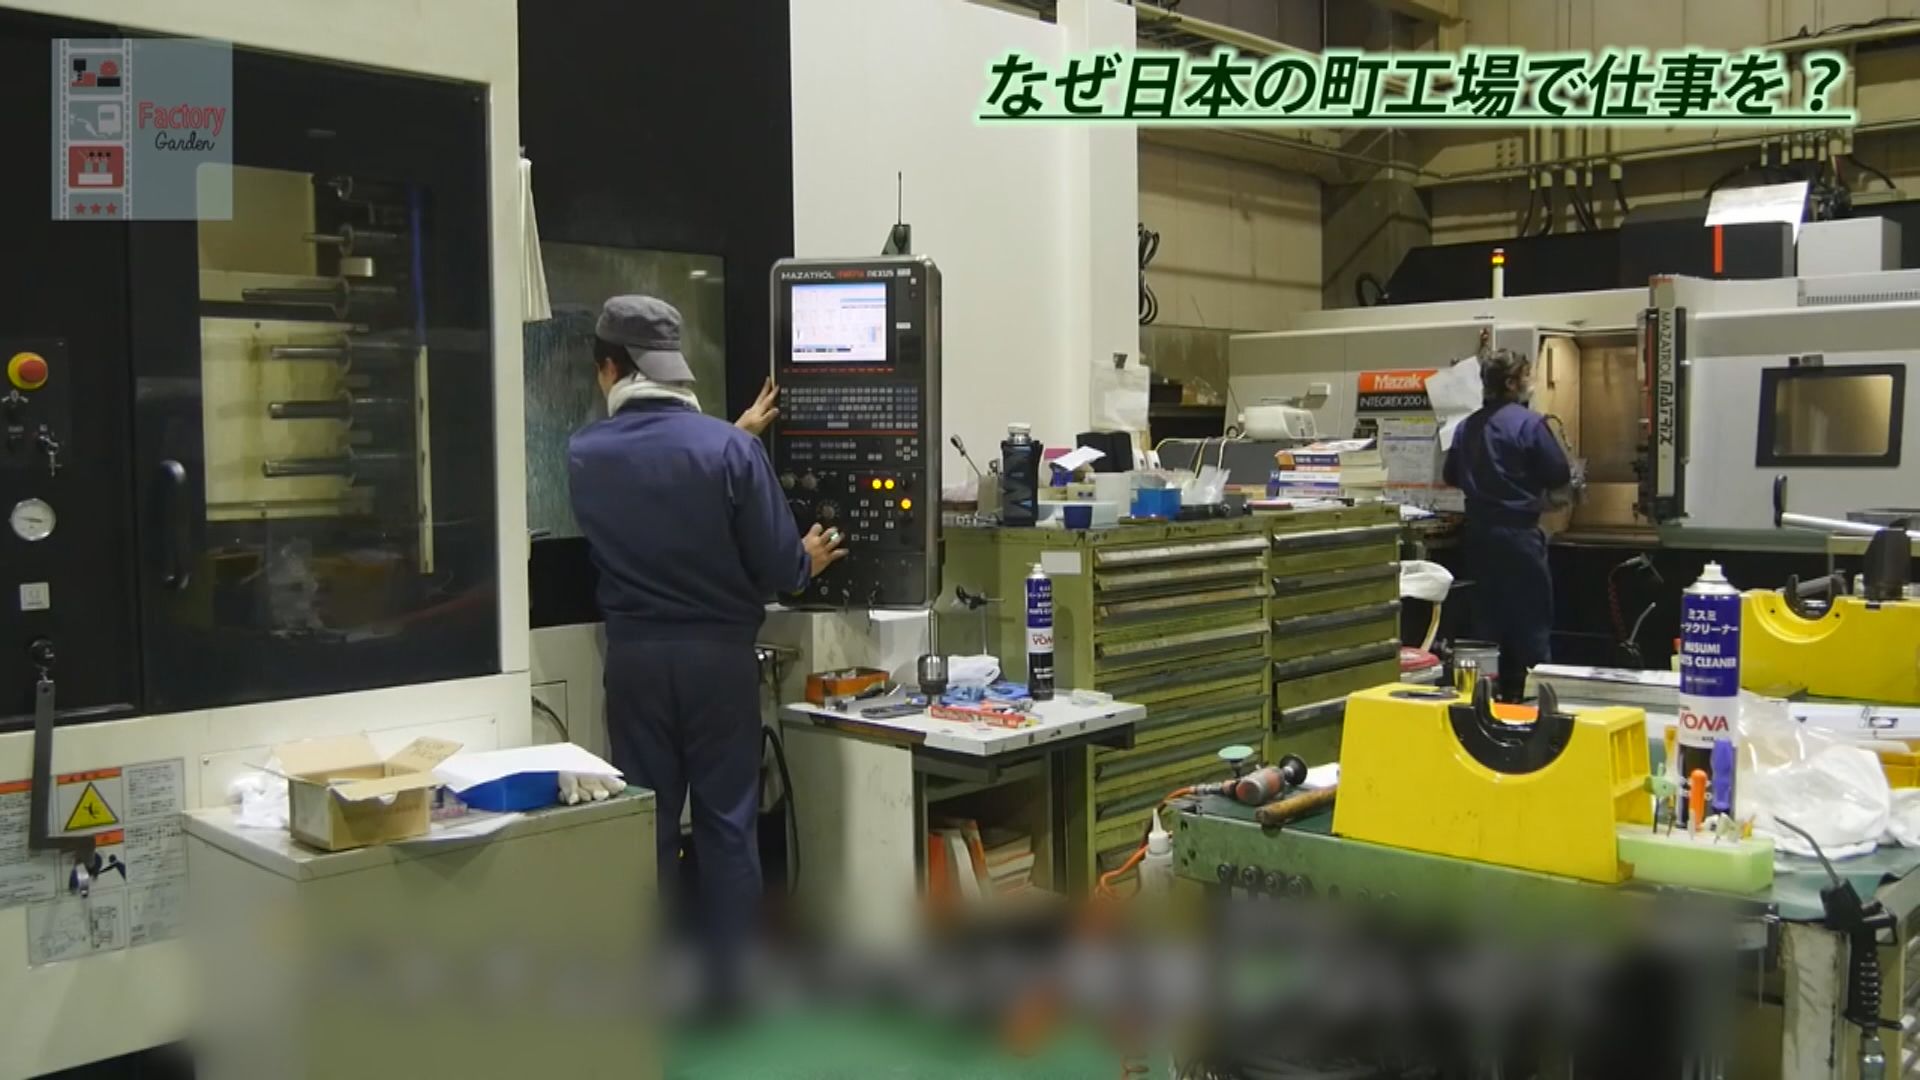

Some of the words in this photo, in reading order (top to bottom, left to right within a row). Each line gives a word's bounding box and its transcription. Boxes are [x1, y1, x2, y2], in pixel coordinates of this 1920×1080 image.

[781, 270, 835, 280] MAZATROL
[1374, 373, 1422, 391] Mazak
[1688, 608, 1716, 621] ミスミ
[1685, 642, 1720, 654] MISUMI
[1696, 656, 1736, 668] CLEANER
